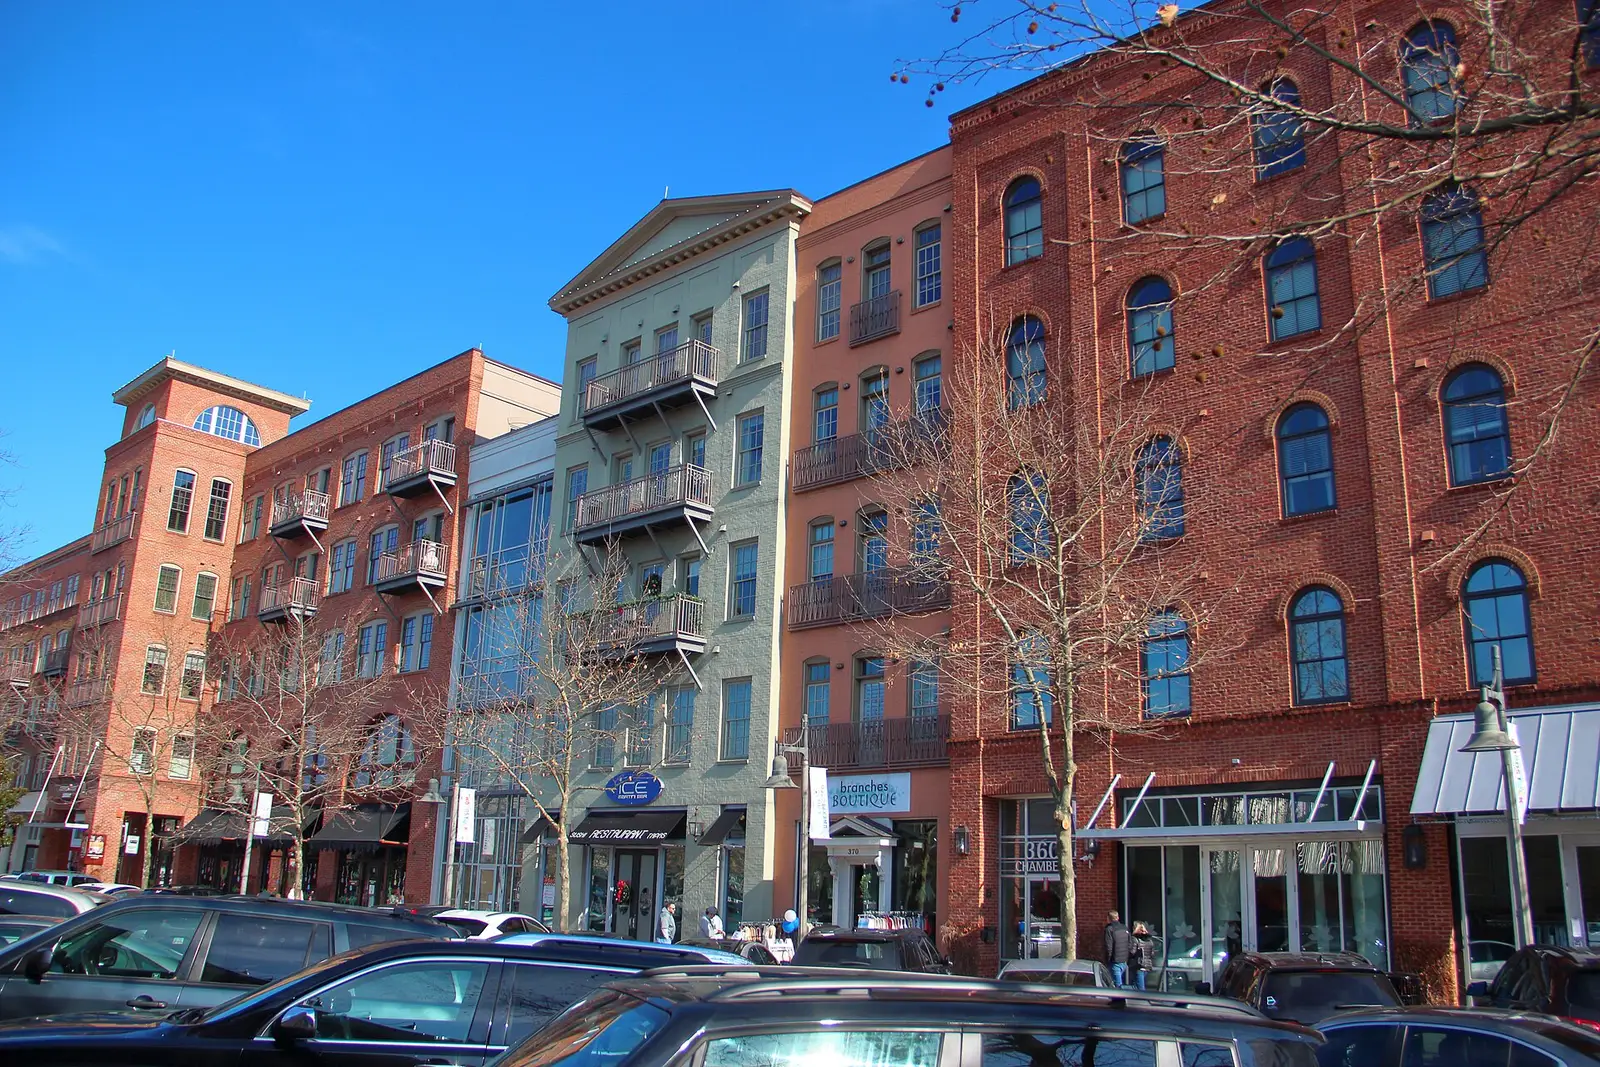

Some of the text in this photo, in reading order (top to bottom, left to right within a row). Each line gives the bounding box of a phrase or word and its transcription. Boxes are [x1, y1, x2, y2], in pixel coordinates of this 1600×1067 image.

[618, 781, 648, 794] ICE
[840, 780, 889, 793] branches
[832, 792, 897, 808] BOUTIQUE
[588, 829, 648, 839] RESTAURANT
[1015, 861, 1059, 872] CHAMBE
